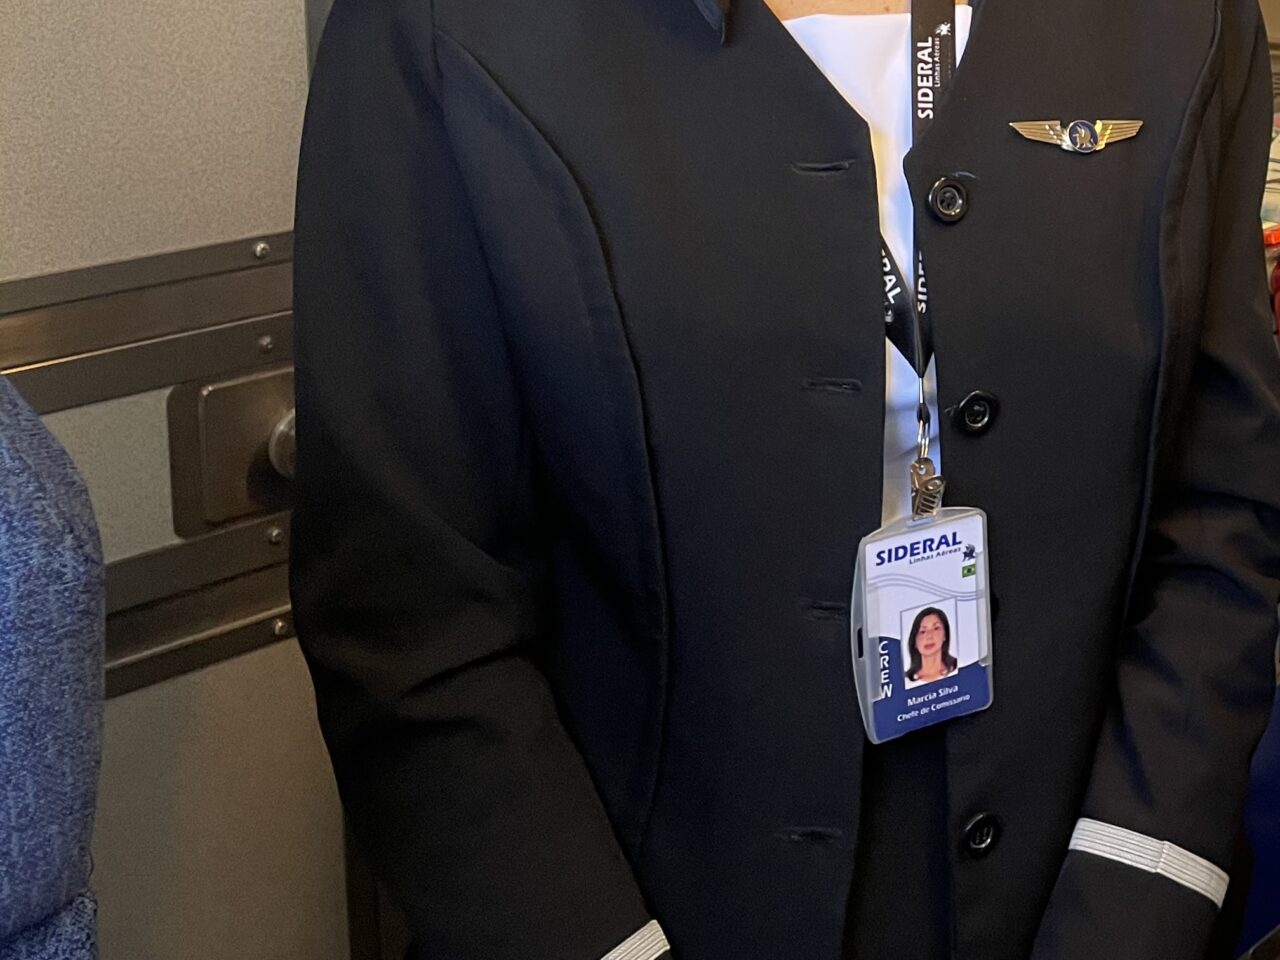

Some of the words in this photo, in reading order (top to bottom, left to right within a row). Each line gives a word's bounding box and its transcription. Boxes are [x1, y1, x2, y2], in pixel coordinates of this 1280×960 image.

[917, 36, 934, 119] SIDERAL
[876, 532, 962, 566] SIDERAL
[909, 554, 934, 565] Linhas
[879, 640, 893, 699] CREW
[938, 685, 958, 697] Silva
